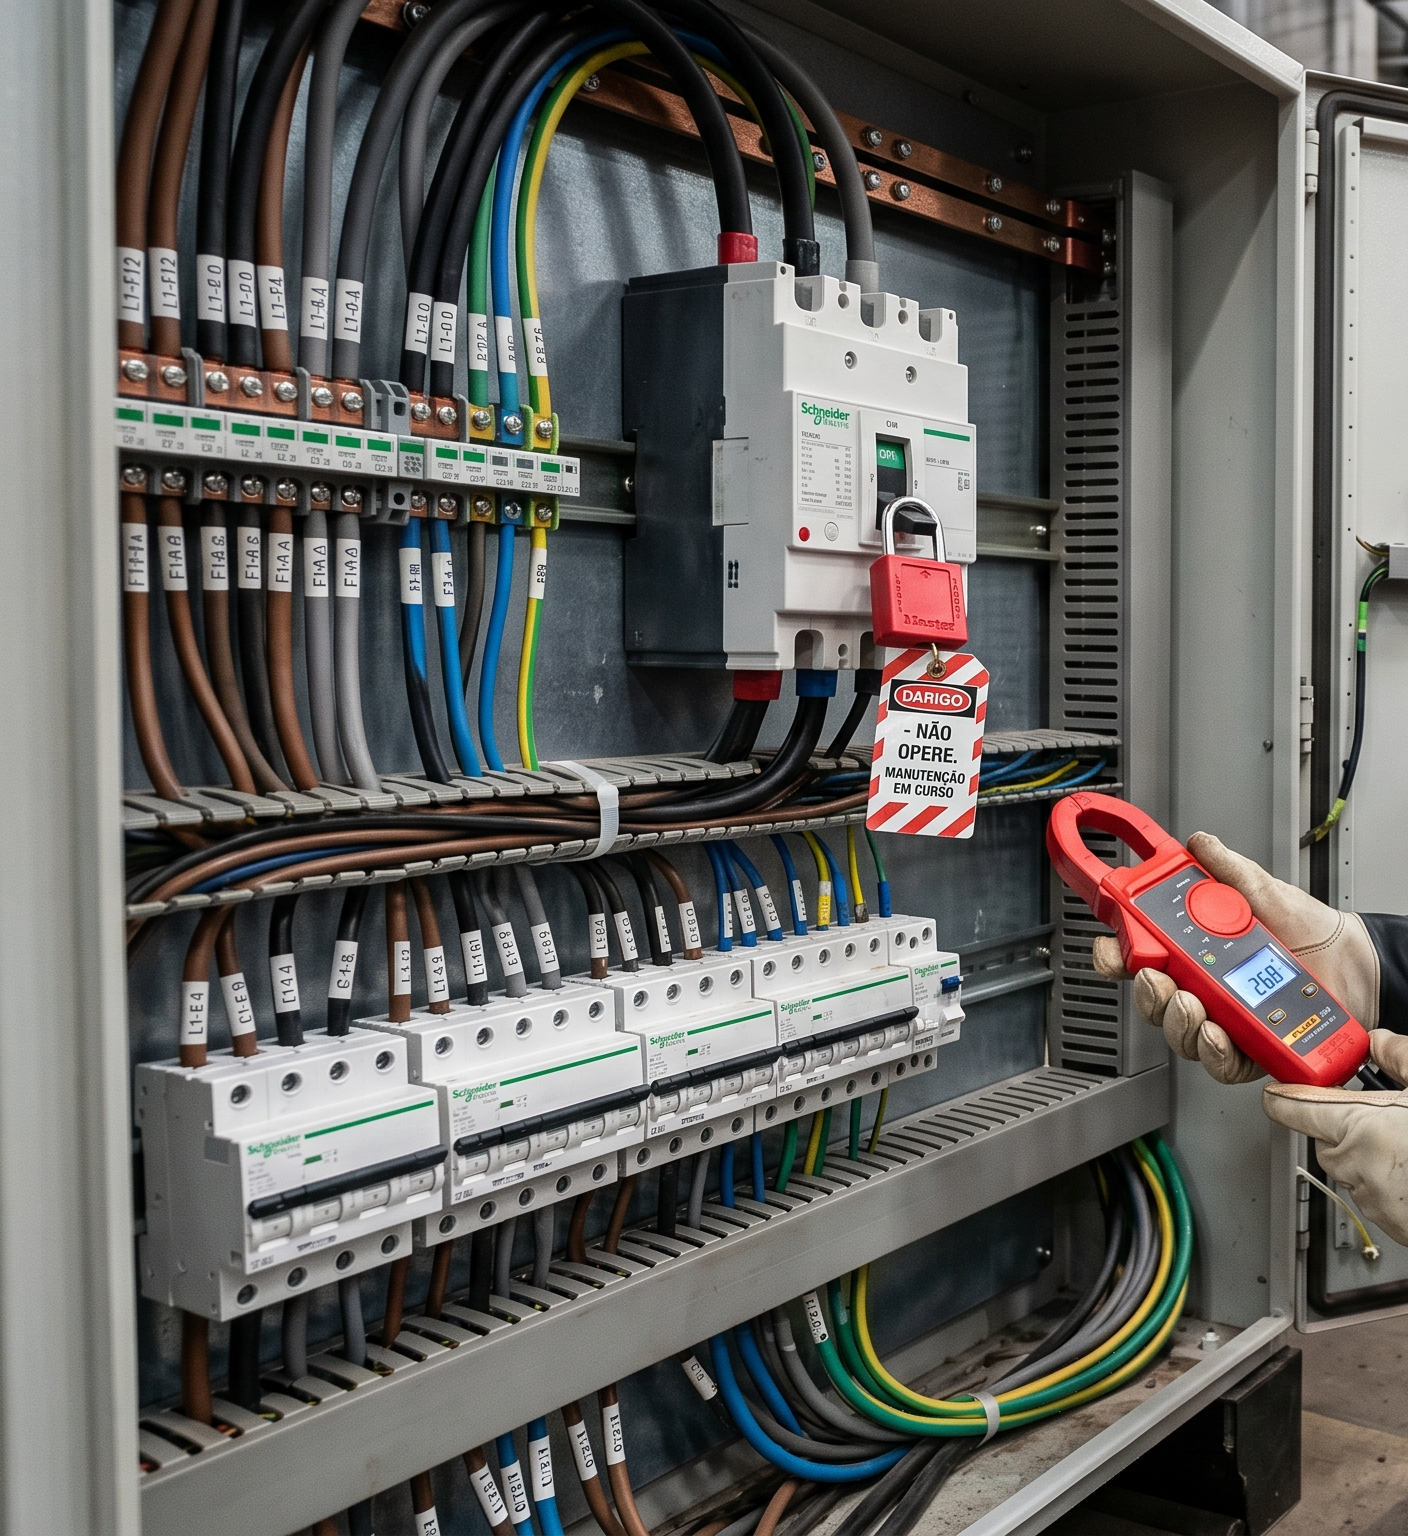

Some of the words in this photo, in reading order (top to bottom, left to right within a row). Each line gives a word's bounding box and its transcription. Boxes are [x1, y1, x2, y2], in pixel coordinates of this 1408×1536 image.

[160, 257, 178, 309] L1-F12
[801, 402, 850, 421] Schneider
[902, 689, 963, 707] DARIGO
[916, 720, 952, 741] NÃO
[898, 743, 958, 764] OPERE.
[885, 766, 965, 786] MANUTENÇÃO
[893, 783, 911, 795] EM
[914, 784, 954, 798] CURSO
